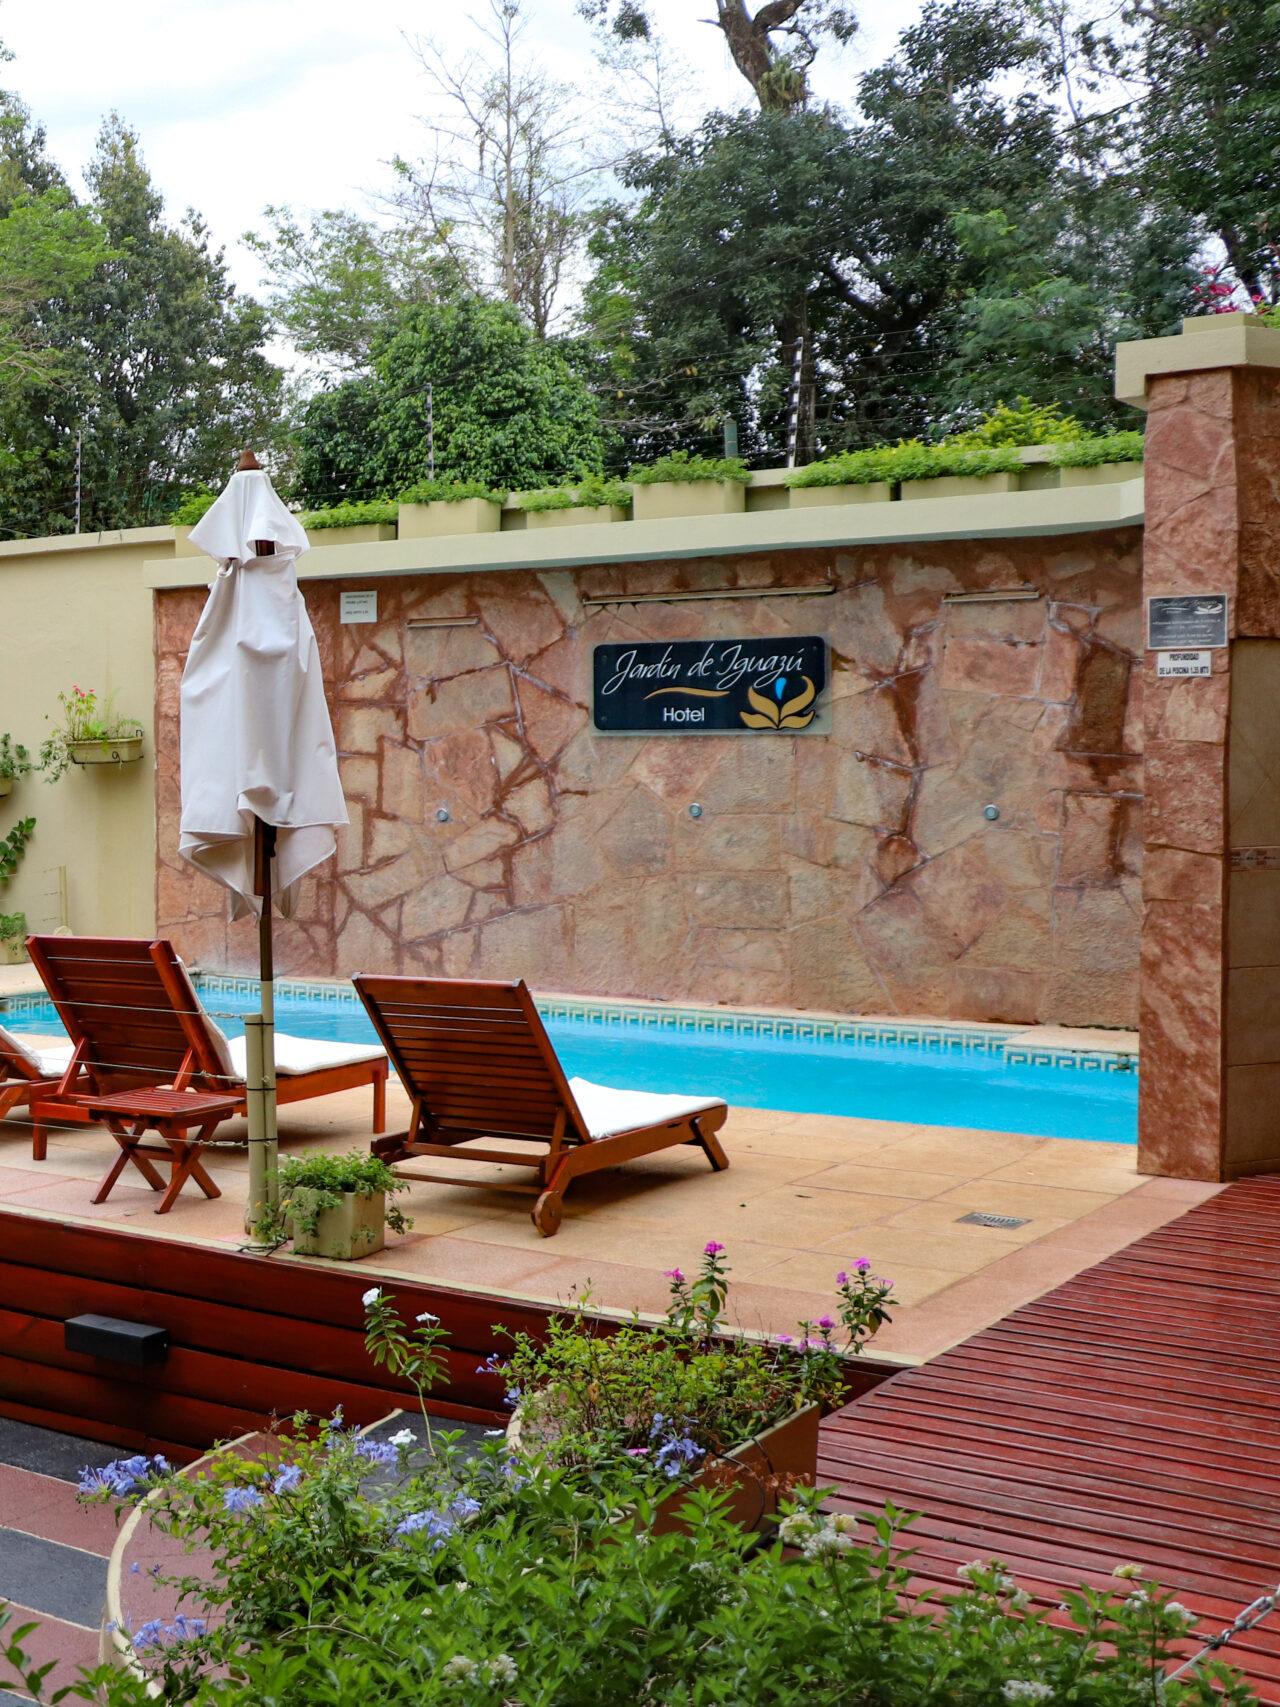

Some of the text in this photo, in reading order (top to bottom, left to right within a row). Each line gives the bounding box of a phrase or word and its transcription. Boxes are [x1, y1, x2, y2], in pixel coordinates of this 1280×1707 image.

[687, 643, 715, 677] de
[716, 644, 805, 690] Iguazú
[663, 707, 705, 722] Hotel
